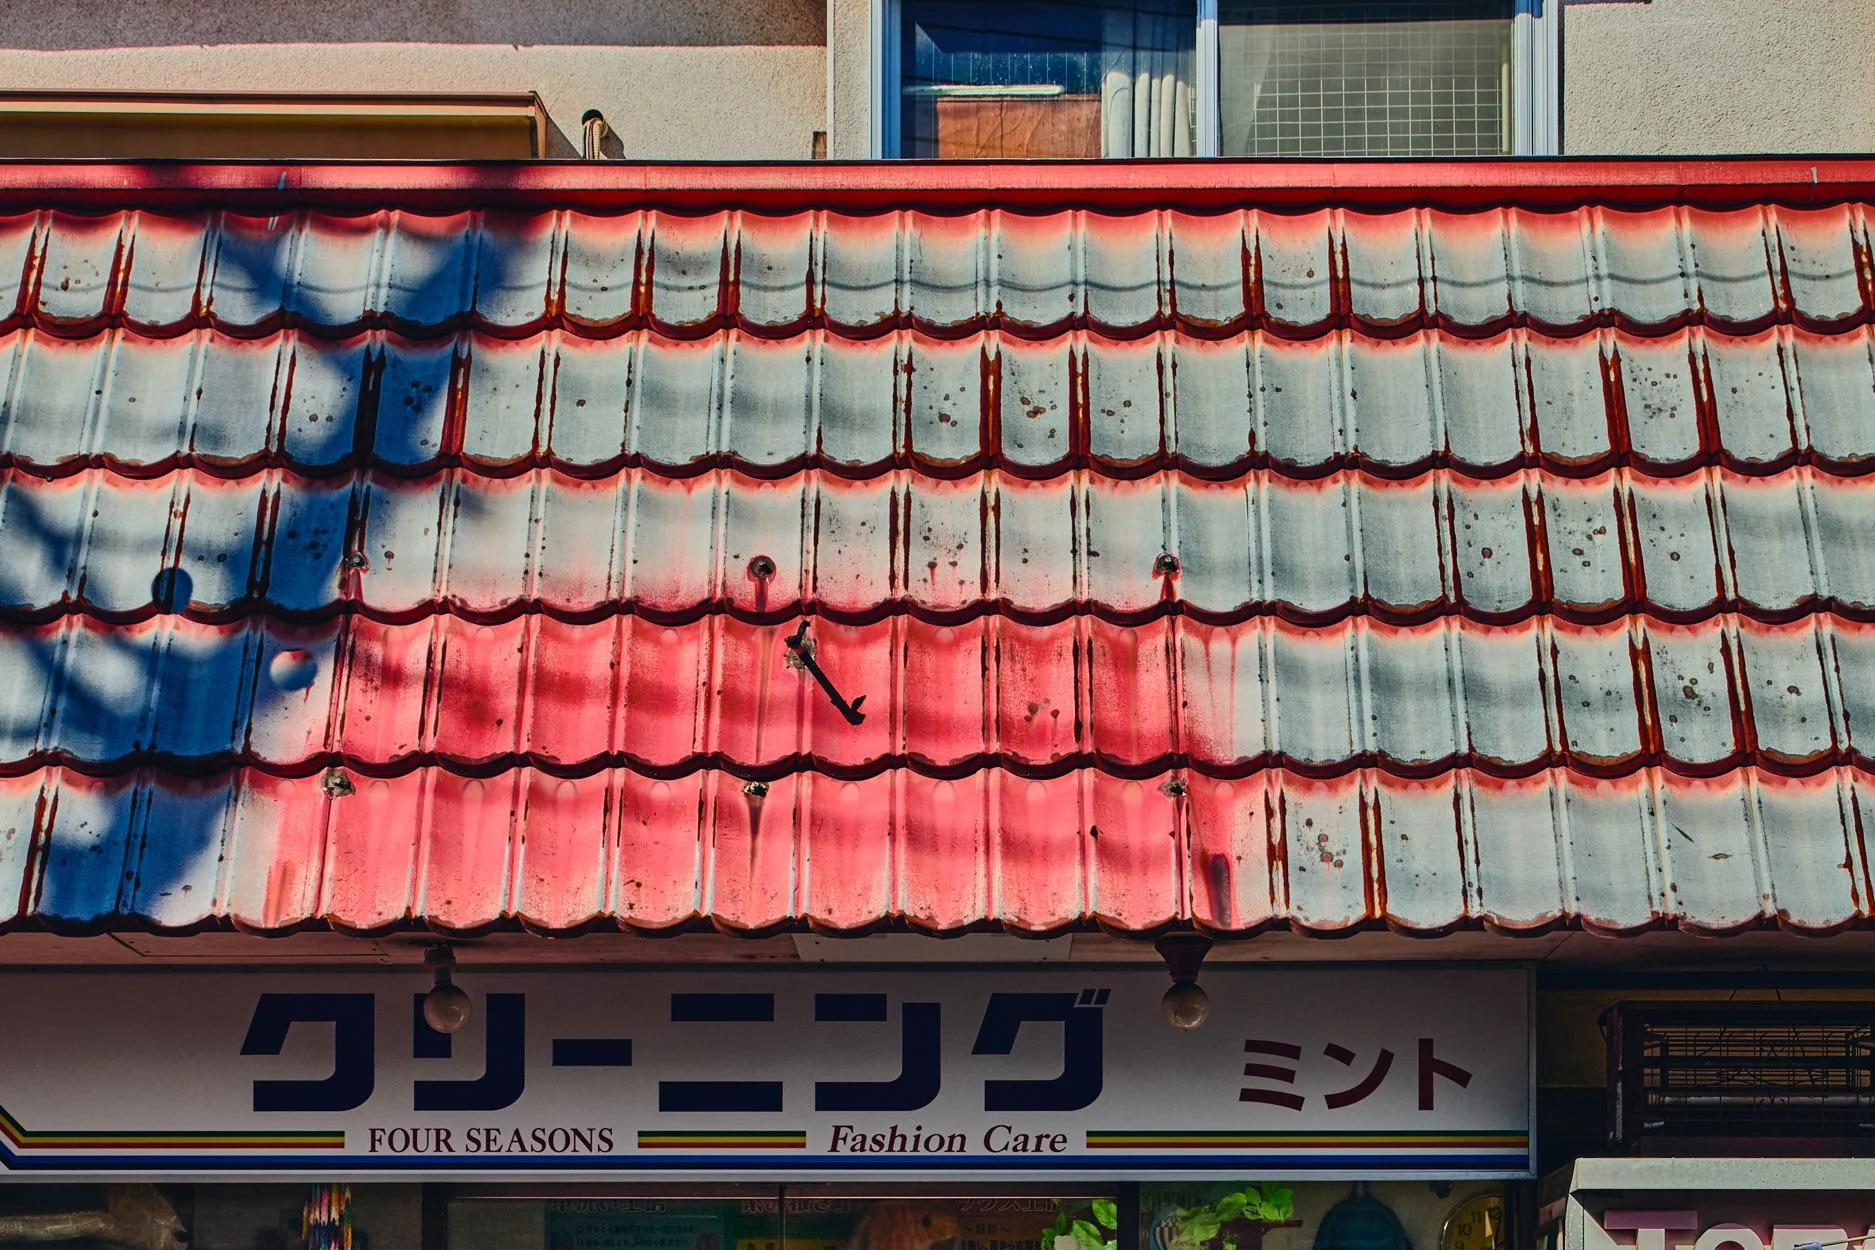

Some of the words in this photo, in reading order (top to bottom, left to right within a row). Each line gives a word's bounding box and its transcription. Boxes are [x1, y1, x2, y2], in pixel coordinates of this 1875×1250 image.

[240, 988, 1111, 1112] クリーニング
[1239, 1038, 1473, 1111] ミント
[368, 1127, 452, 1154] FOUR
[465, 1127, 615, 1154] SEASONS
[827, 1124, 968, 1154] Fashion
[983, 1124, 1069, 1154] Care
